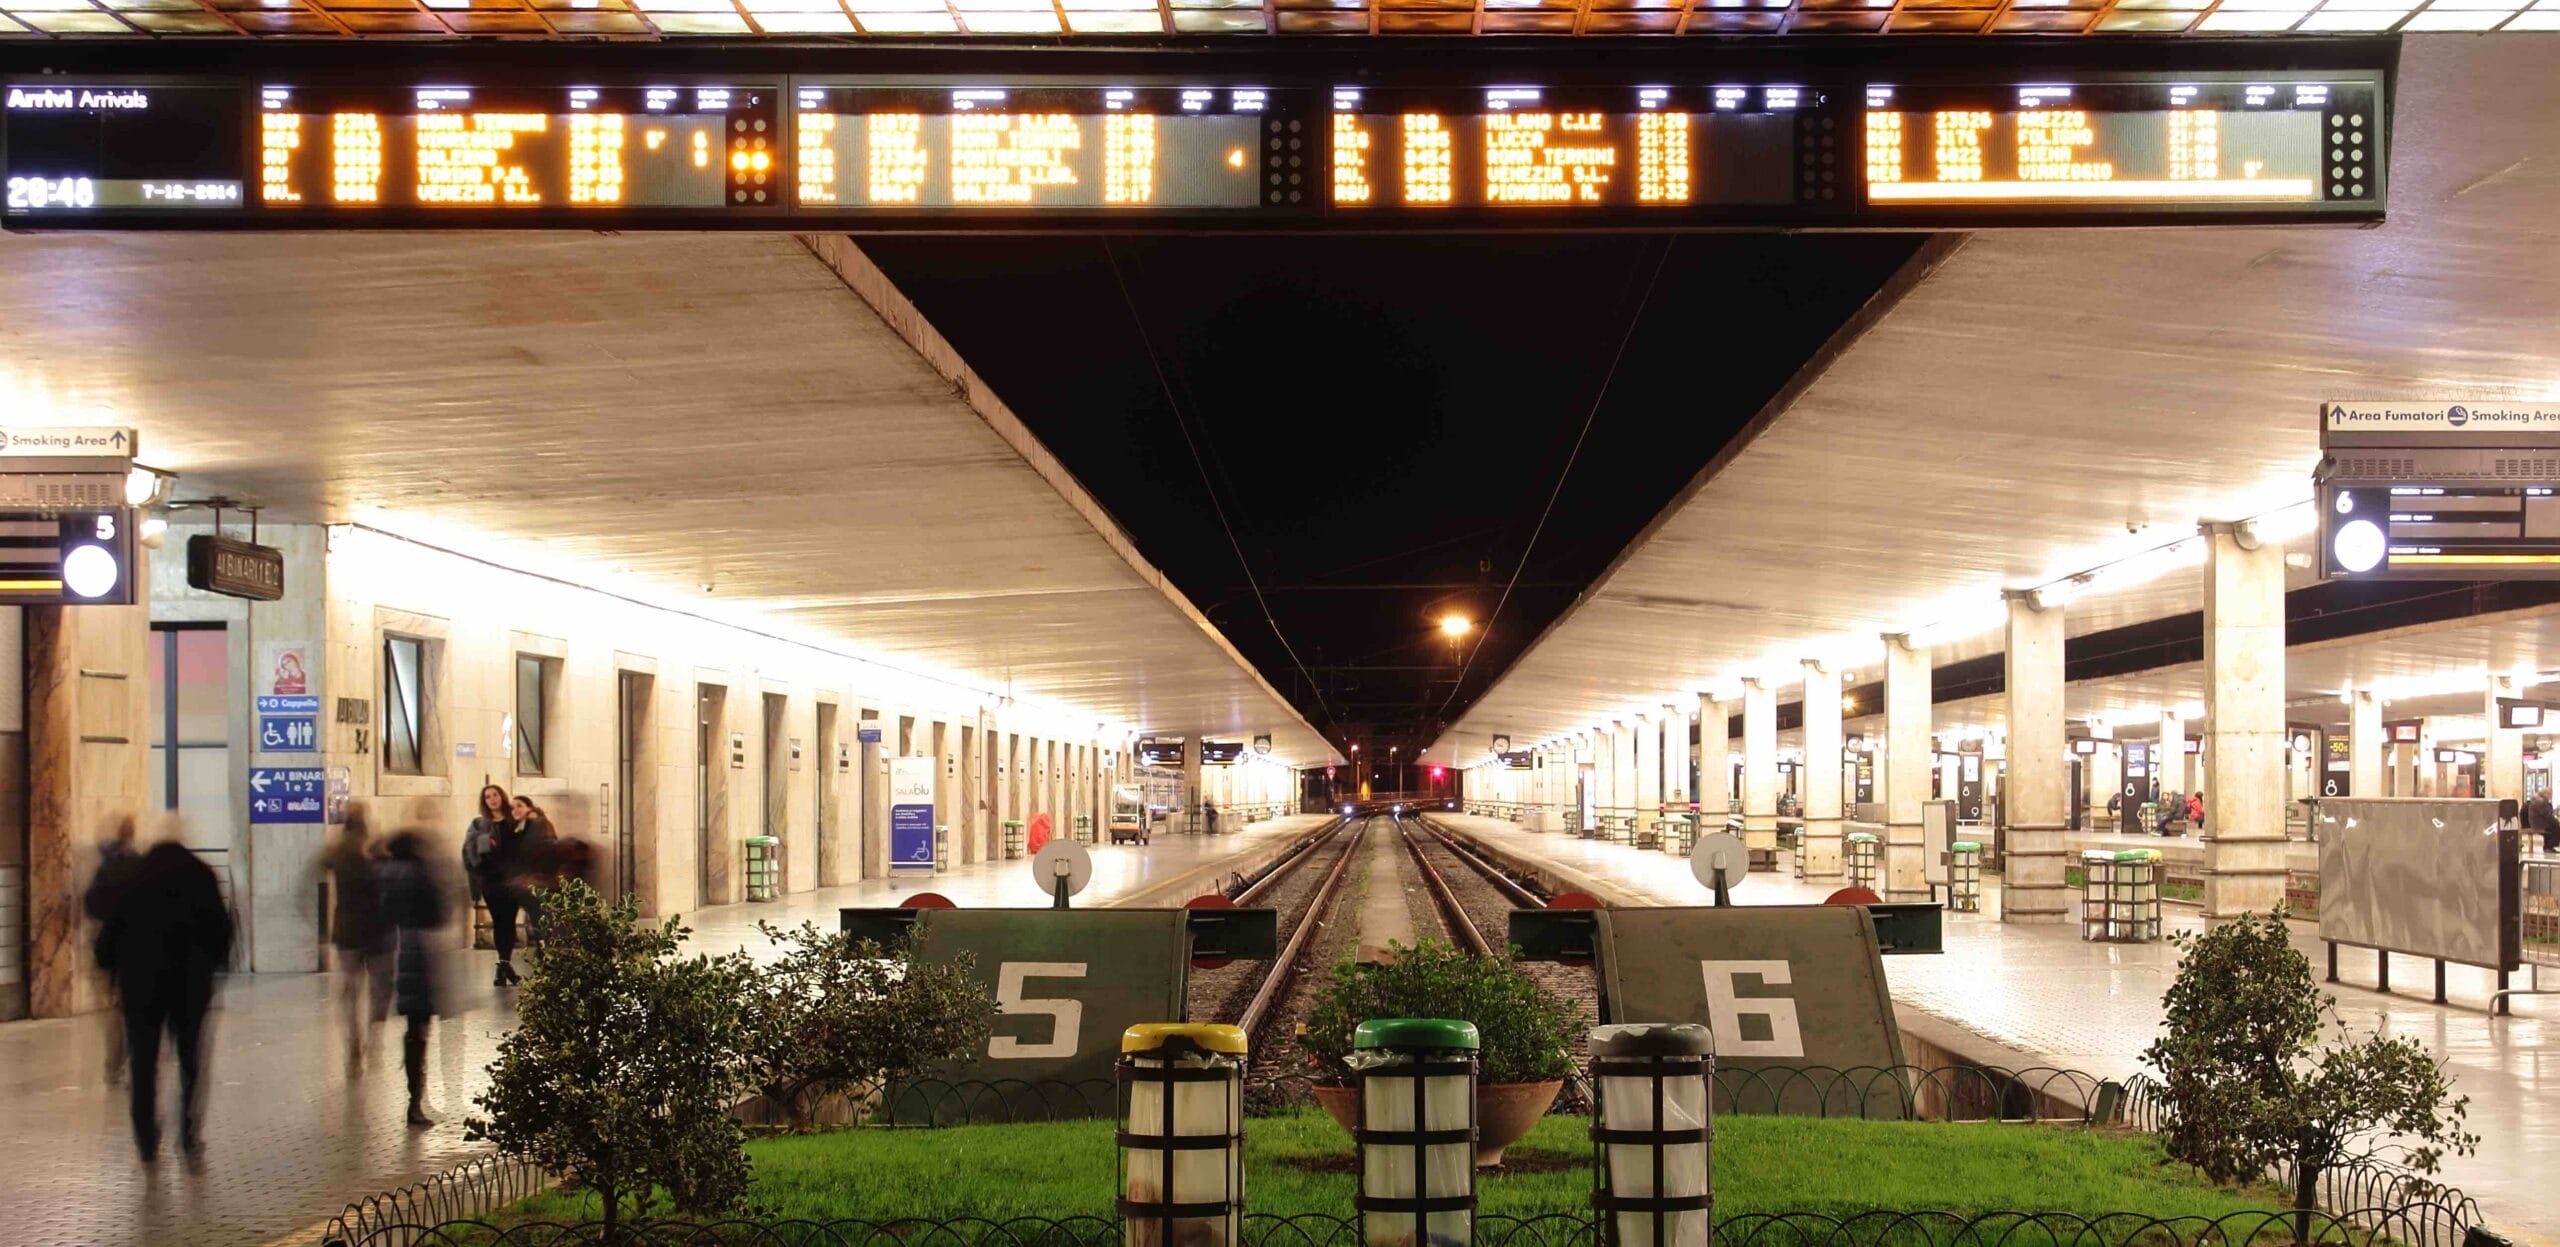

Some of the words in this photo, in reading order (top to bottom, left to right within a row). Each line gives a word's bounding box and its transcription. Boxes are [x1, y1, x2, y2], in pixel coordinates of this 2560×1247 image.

[8, 89, 73, 108] Arrivi
[79, 90, 147, 108] Arrivals
[1334, 114, 1354, 130] IC
[1487, 114, 1551, 130] MILANO
[1639, 114, 1688, 130] 21:20
[2017, 111, 2085, 128] AREZZO
[1487, 131, 1543, 149] LUCCA
[1639, 131, 1688, 149] 21:22
[2018, 129, 2092, 145] FOLIGNO
[1487, 149, 1532, 165] ROMA
[1543, 149, 1614, 165] TERMINI
[1639, 149, 1688, 165] 21:22
[418, 166, 482, 182] TORINO
[1487, 166, 1563, 183] VENEZIA
[1639, 166, 1688, 183] 21:30
[2018, 164, 2112, 181] VIAREGGIO
[8, 178, 94, 207] 20:48
[142, 184, 237, 199] 7-12-2014
[418, 183, 493, 200] VENEZIA
[1487, 184, 1571, 201] PIOMBINO
[1639, 184, 1688, 201] 21:32
[2349, 410, 2381, 421] Area
[2385, 410, 2444, 421] Fumatori
[2472, 410, 2529, 423] Smoking
[12, 435, 70, 448] Smoking
[74, 436, 107, 446] Area
[2336, 491, 2353, 513] 6
[96, 515, 115, 540] 5
[273, 771, 285, 781] AI
[289, 771, 324, 781] BINARI
[285, 782, 290, 792] 1
[294, 784, 301, 792] e
[305, 782, 313, 792] 2
[988, 962, 1087, 1058] 5
[1702, 960, 1804, 1057] 6
